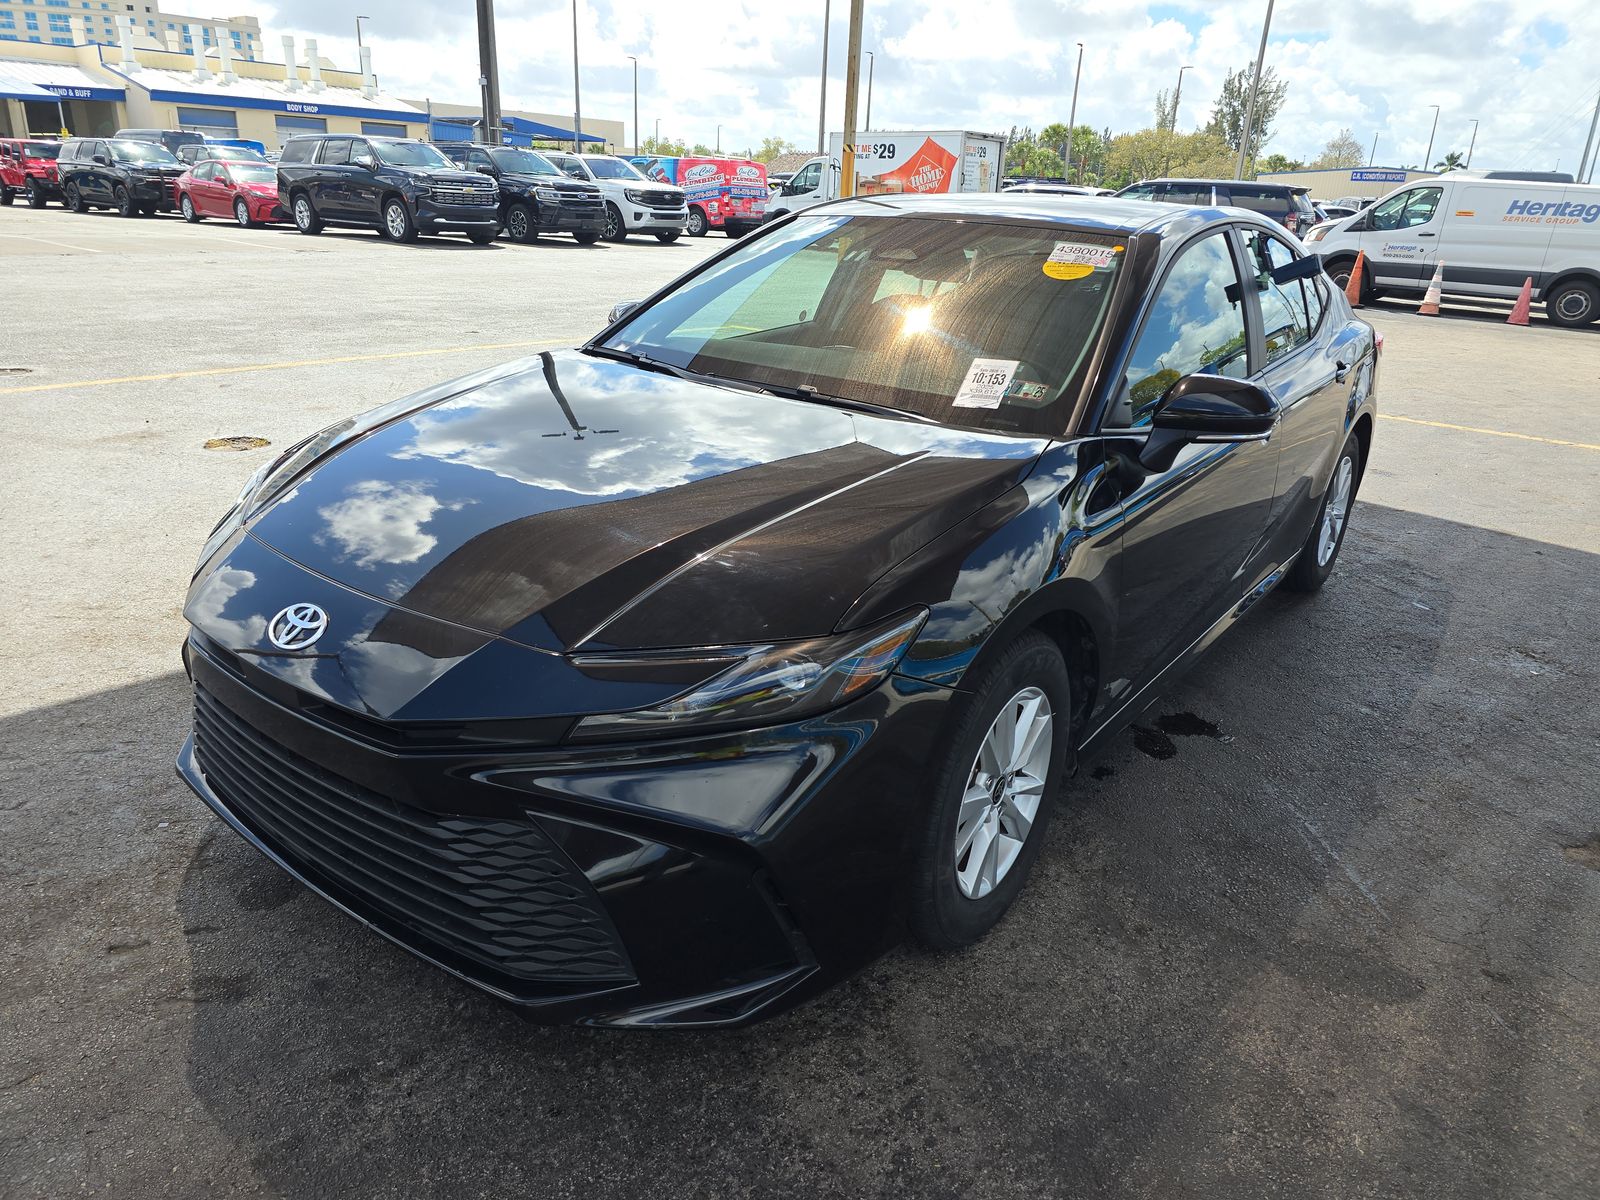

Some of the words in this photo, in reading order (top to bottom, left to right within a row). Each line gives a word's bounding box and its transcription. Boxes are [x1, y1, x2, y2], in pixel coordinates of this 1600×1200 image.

[49, 87, 67, 96] SAND
[68, 88, 74, 97] &
[74, 89, 91, 98] BUFF
[286, 103, 302, 111] BODY
[302, 104, 319, 113] SHOP
[861, 144, 872, 152] ME
[872, 143, 896, 159] $29
[976, 146, 987, 158] $29
[687, 169, 698, 180] Joe
[918, 164, 931, 174] THE
[678, 174, 722, 187] PLUMBING
[910, 167, 943, 187] HOME
[918, 181, 938, 192] DEPOT
[1506, 200, 1600, 223] Heritag
[1502, 215, 1543, 224] SERVICE
[1545, 216, 1579, 225] GROUP
[1056, 246, 1114, 258] 4380015
[971, 371, 1007, 386] 10:153
